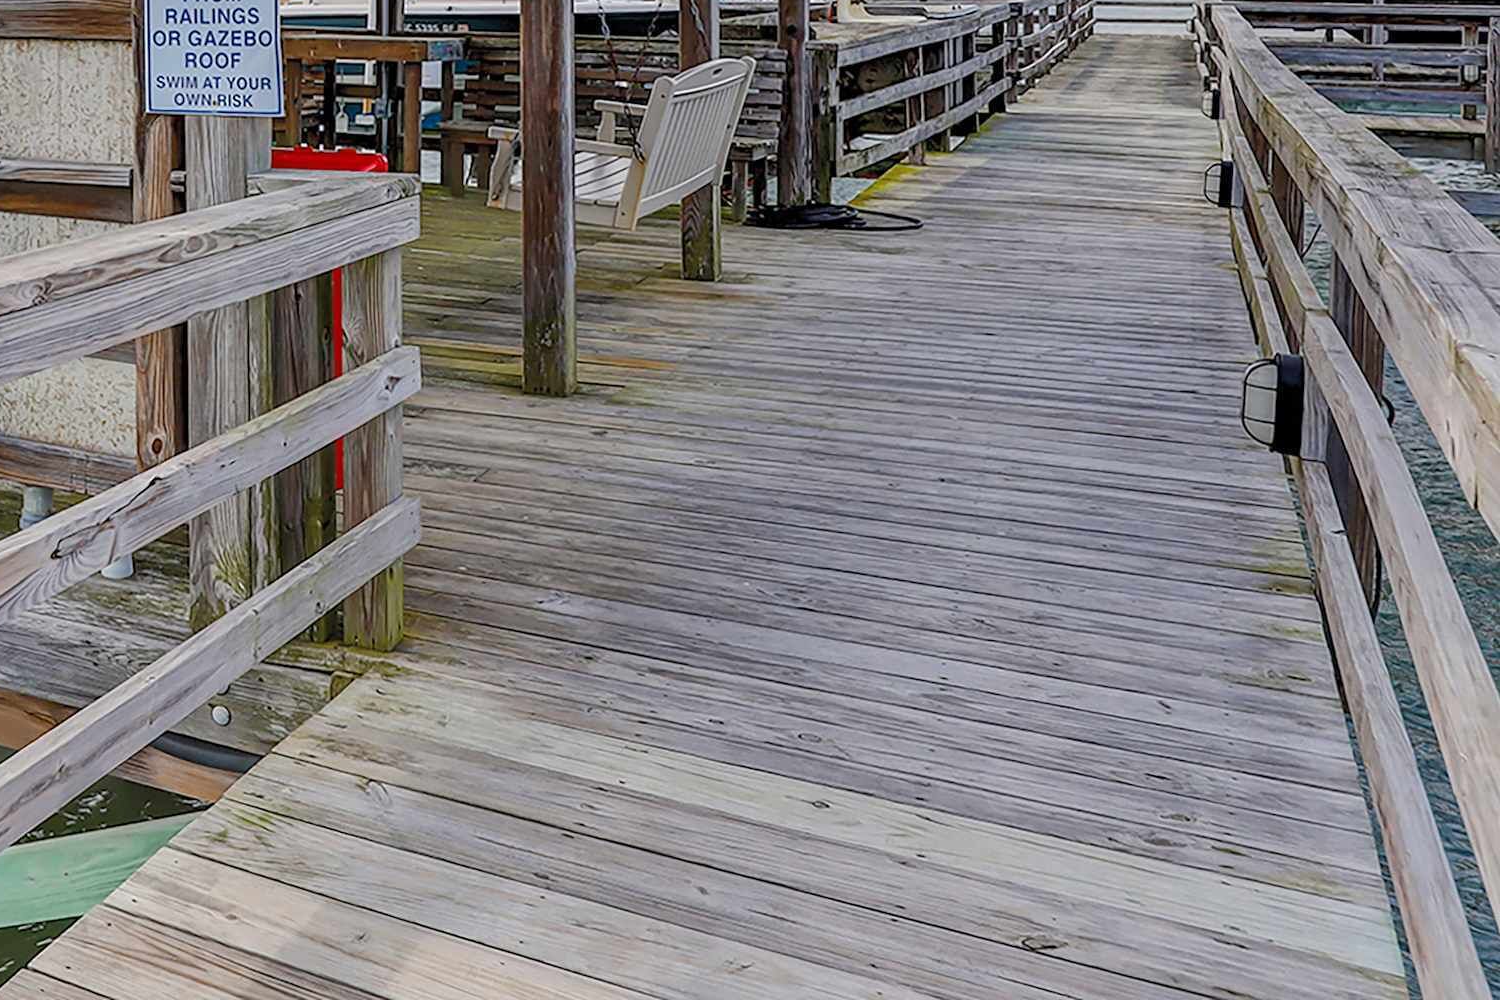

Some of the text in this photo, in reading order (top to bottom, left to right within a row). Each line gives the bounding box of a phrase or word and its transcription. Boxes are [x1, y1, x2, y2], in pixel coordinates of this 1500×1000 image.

[165, 7, 260, 24] RAILINGS
[153, 30, 273, 47] OR GAZEBO
[185, 52, 241, 69] ROOF
[156, 75, 271, 90] SWIM AT YOUR
[174, 93, 253, 108] OWN RISK
